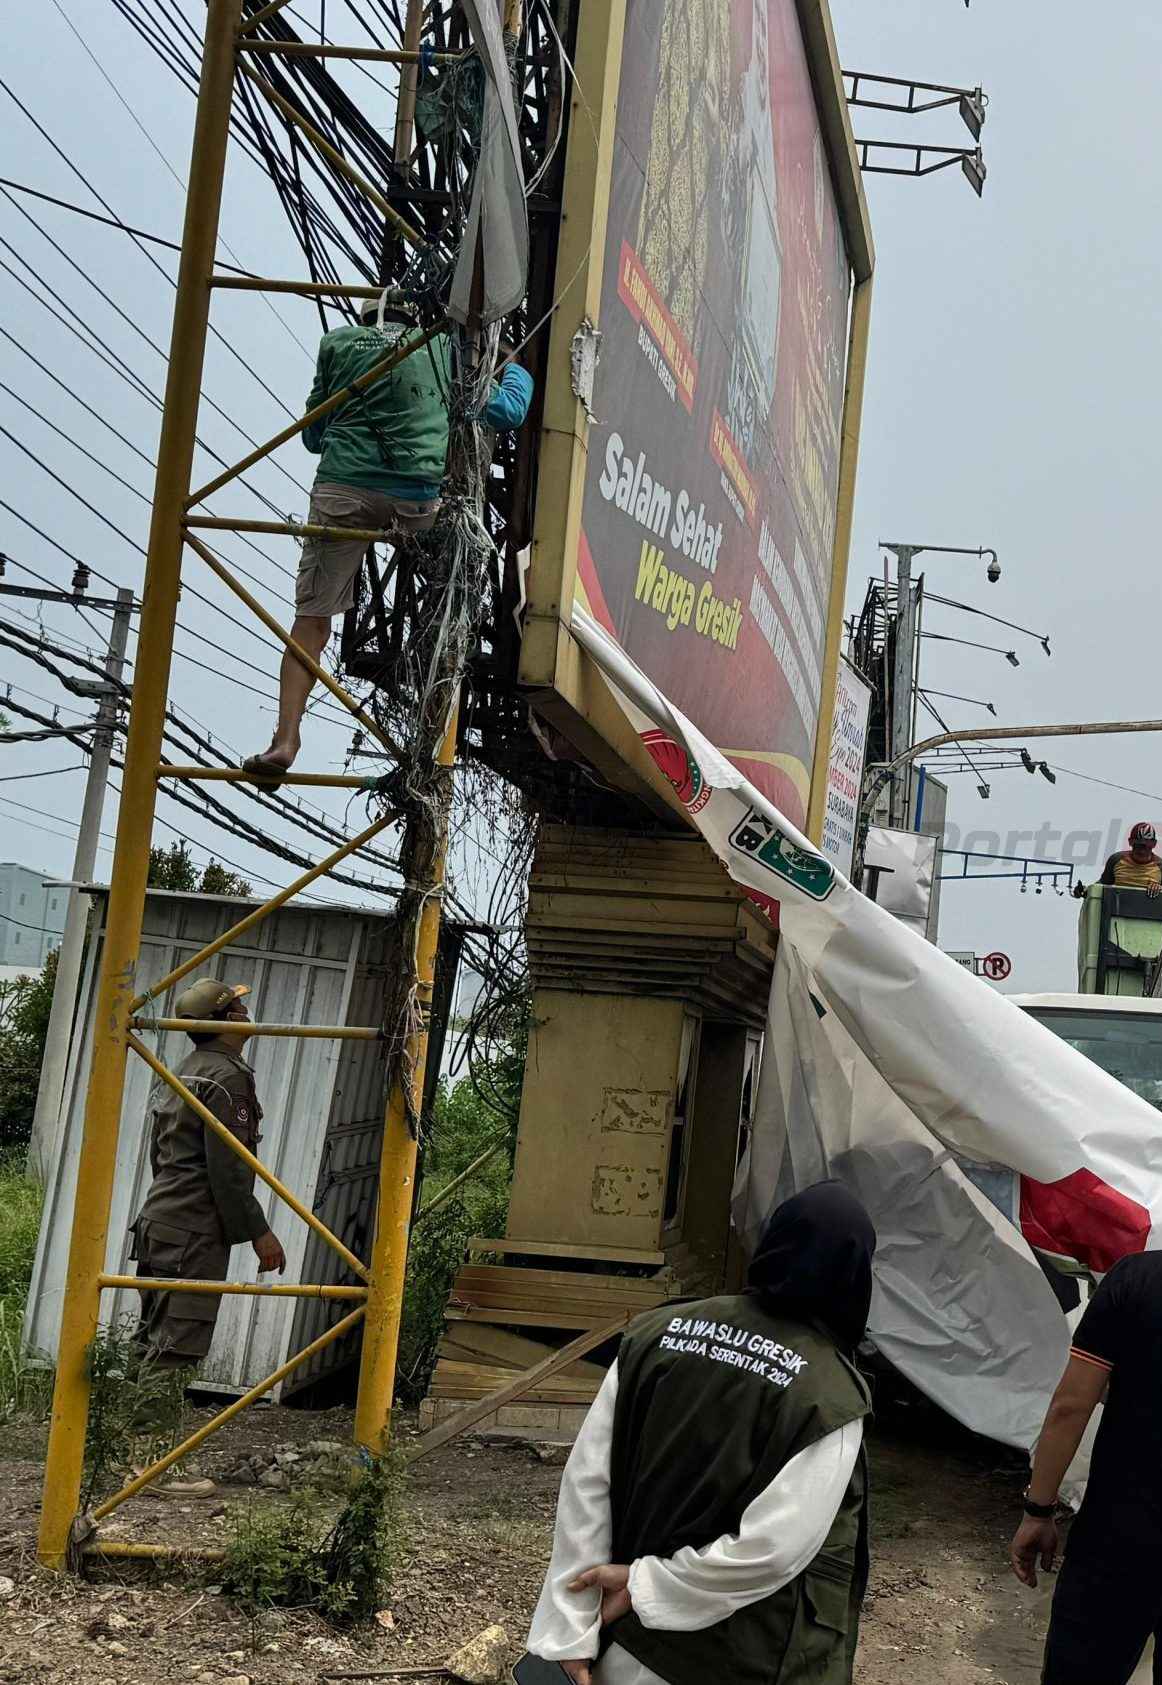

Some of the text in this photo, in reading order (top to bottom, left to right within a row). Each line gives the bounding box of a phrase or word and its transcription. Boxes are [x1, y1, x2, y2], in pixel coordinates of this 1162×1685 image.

[599, 431, 672, 539] Salam
[670, 489, 723, 575] Sehat
[634, 540, 696, 632] Warga
[695, 580, 743, 651] Gresik
[659, 1335, 793, 1388] PILKADA SERENTAK 2024
[667, 1317, 808, 1375] BAWASLU GRESIK
